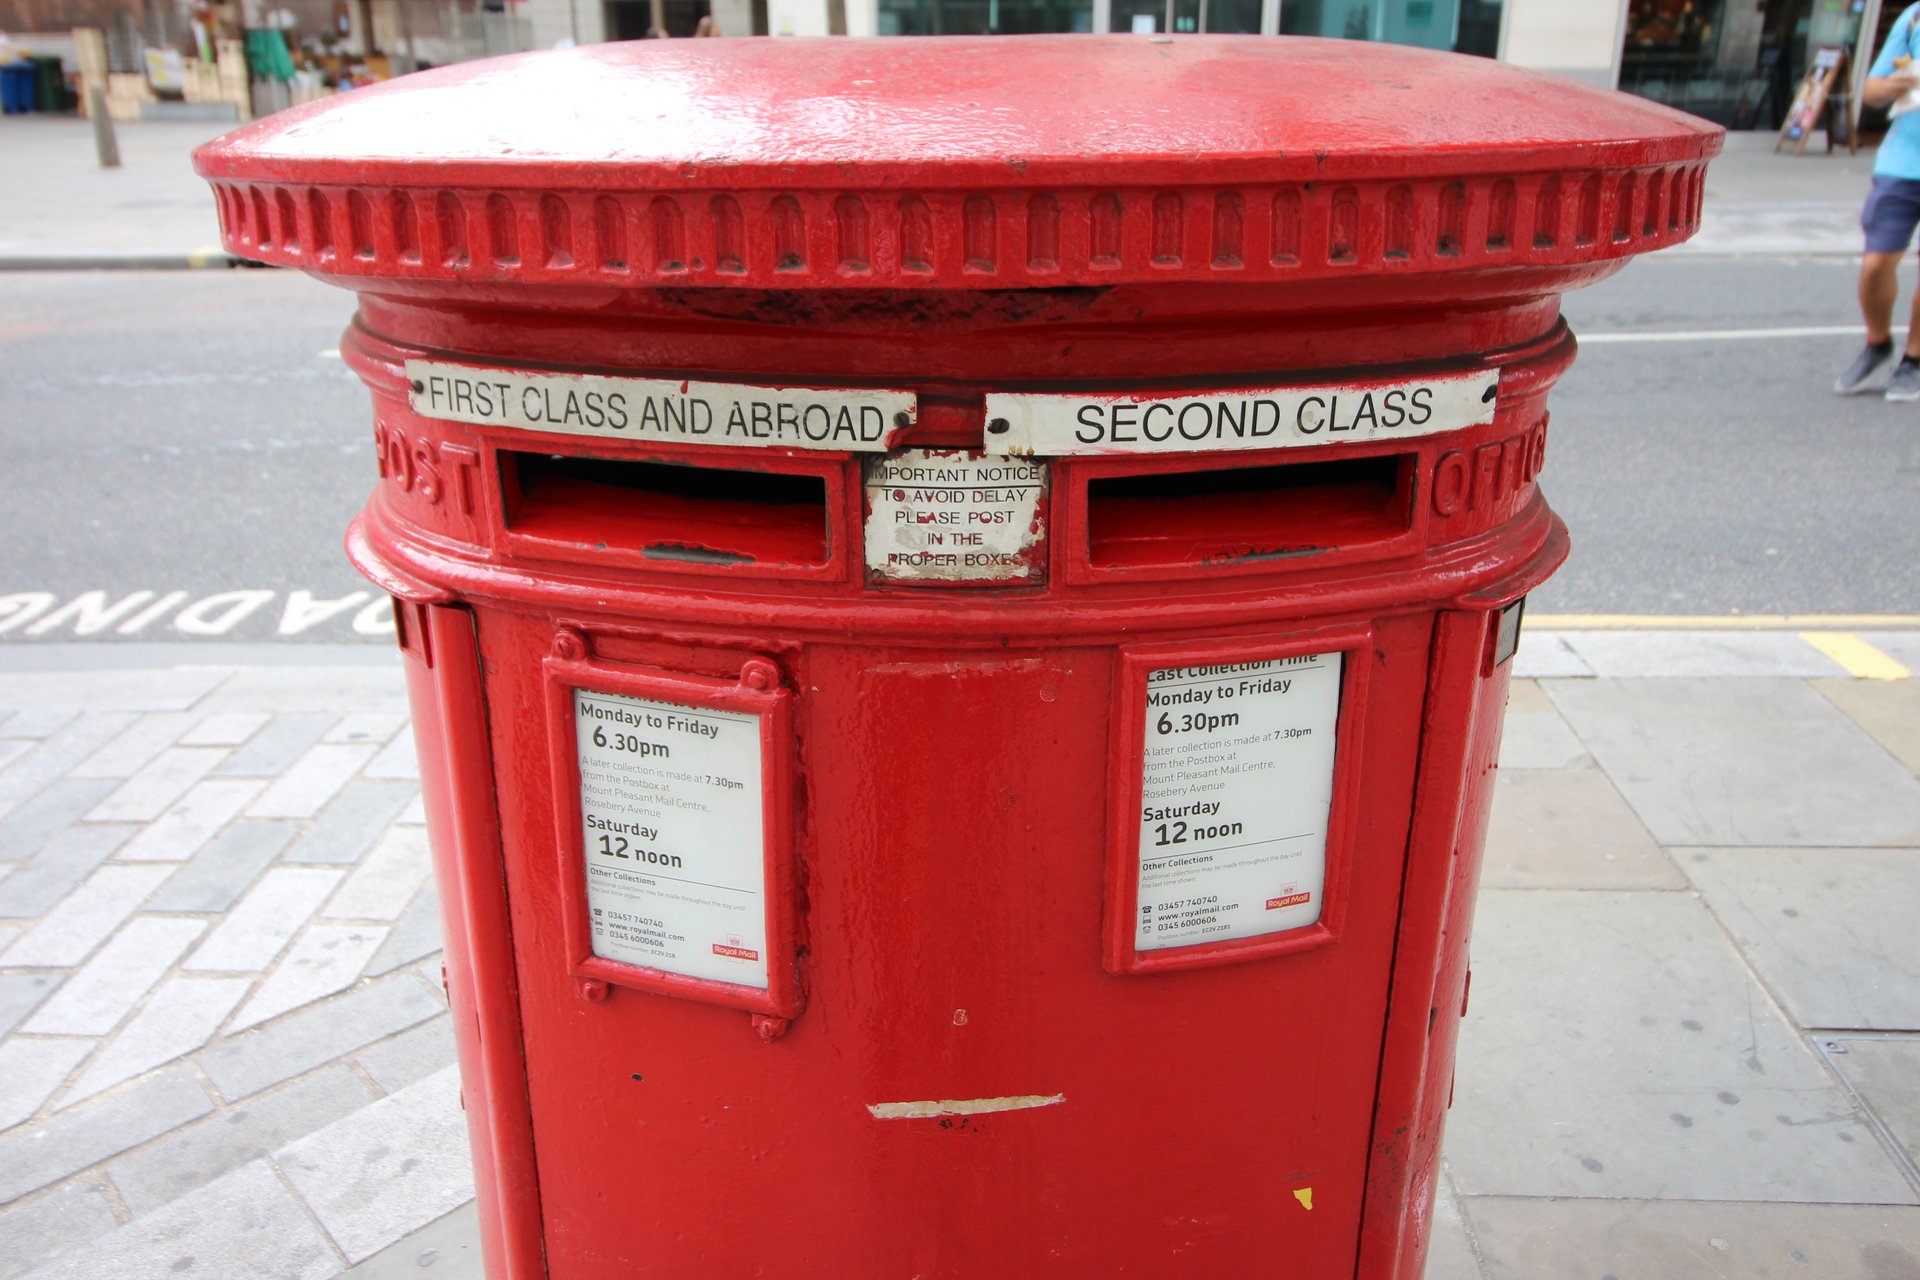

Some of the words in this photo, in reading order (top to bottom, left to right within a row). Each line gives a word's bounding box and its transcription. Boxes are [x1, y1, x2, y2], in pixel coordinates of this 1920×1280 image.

[429, 375, 511, 418] FIRST
[522, 386, 628, 430] CLASS
[640, 395, 713, 434] AND
[726, 400, 884, 442] ABROAD
[1075, 399, 1280, 444] SECOND
[1296, 387, 1433, 435] CLASS
[376, 419, 478, 516] POST
[1434, 410, 1550, 516] OFFIC
[870, 466, 969, 482] IMPORTANT
[977, 466, 1040, 481] NOTICE
[882, 488, 906, 502] TO
[913, 489, 965, 503] AVOID
[973, 488, 1028, 503] DELAY
[895, 511, 960, 525] PLEASE
[968, 511, 1015, 525] POST
[927, 533, 943, 546] IN
[950, 532, 984, 546] THE
[888, 552, 957, 567] PROPER
[1147, 667, 1183, 682] Last
[1188, 659, 1271, 678] Collection
[1146, 688, 1213, 708] Monday
[1217, 685, 1234, 699] to
[1239, 678, 1292, 697] Friday
[580, 702, 642, 728] Monday
[646, 714, 662, 729] to
[667, 716, 719, 739] Friday
[1157, 711, 1240, 735] 6.30pm
[592, 725, 670, 758] 6.30pm
[1144, 748, 1150, 757] A
[1152, 747, 1174, 756] later
[1177, 740, 1222, 753] collection
[1224, 739, 1231, 747] is
[1234, 734, 1260, 746] made
[1262, 733, 1272, 742] at
[1274, 727, 1312, 741] 7.30pm
[1144, 762, 1167, 771] from
[1169, 758, 1185, 768] the
[1187, 754, 1225, 766] Postbox
[1227, 752, 1237, 760] at
[582, 756, 589, 765] A
[590, 757, 611, 769] later
[612, 762, 655, 776] collection
[656, 769, 664, 777] is
[666, 771, 692, 782] made
[694, 776, 703, 784] at
[705, 775, 744, 790] 7.30pm
[583, 770, 605, 781] from
[606, 774, 621, 784] the
[623, 776, 660, 790] Postbox
[661, 784, 670, 793] at
[1143, 773, 1174, 785] Mount
[1177, 768, 1218, 781] Pleasant
[1220, 765, 1240, 775] Mail
[583, 783, 614, 797] Mount
[615, 788, 653, 803] Pleasant
[655, 795, 674, 807] Mail
[1143, 786, 1188, 799] Rosebery
[1190, 782, 1225, 793] Avenue
[584, 796, 626, 812] Rosebery
[628, 804, 661, 817] Avenue
[1143, 801, 1221, 822] Saturday
[587, 814, 658, 841] Saturday
[1155, 821, 1187, 846] 12
[1194, 822, 1243, 841] noon
[599, 834, 629, 859] 12
[635, 849, 682, 868] noon
[1142, 862, 1167, 871] Other
[1168, 856, 1213, 868] Collections
[590, 867, 612, 878] Other
[613, 872, 656, 886] Collections
[1158, 900, 1184, 911] 03457
[1186, 895, 1217, 907] 740740
[1268, 897, 1290, 908] Royal
[1291, 894, 1308, 903] Mail
[608, 911, 632, 922] 03457
[634, 916, 664, 928] 740740
[1158, 903, 1239, 921] www.royalmail.com
[609, 922, 685, 942] www.royalmail.com
[1158, 921, 1179, 931] 0345
[1181, 916, 1217, 928] 6000606
[610, 930, 629, 941] 0345
[631, 935, 665, 948] 6000606
[714, 945, 737, 956] Royal
[738, 949, 757, 959] Mail
